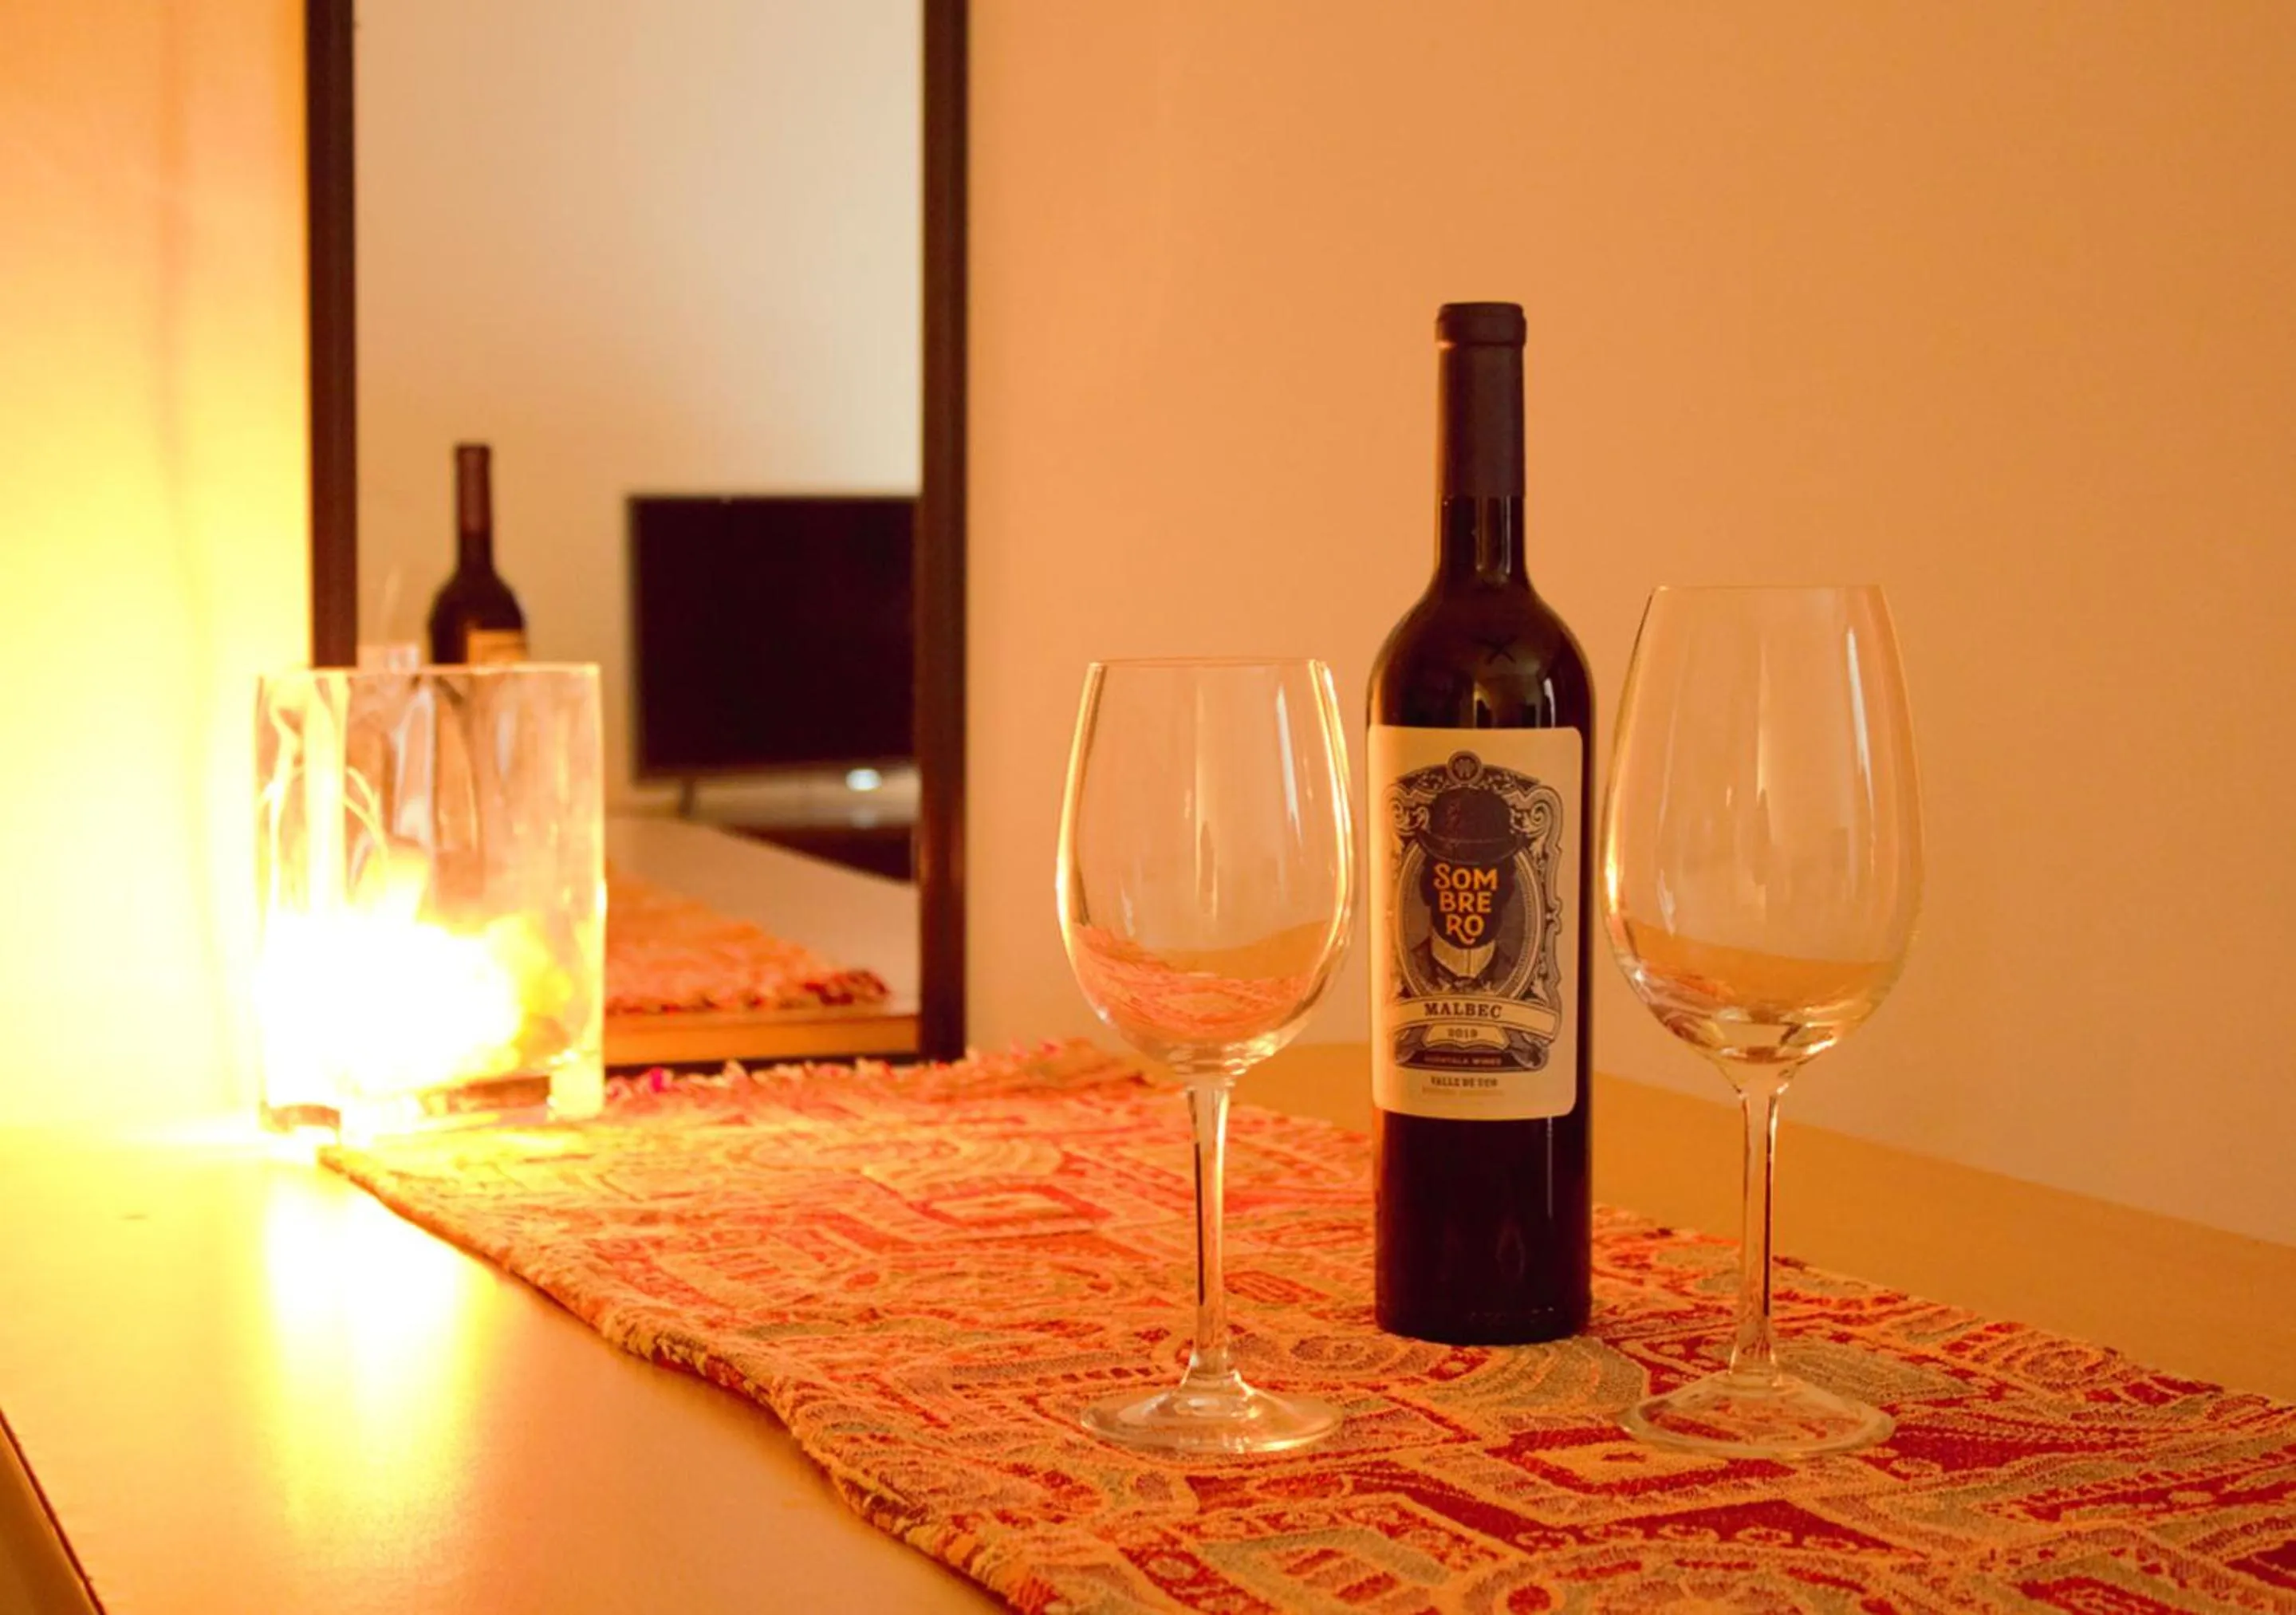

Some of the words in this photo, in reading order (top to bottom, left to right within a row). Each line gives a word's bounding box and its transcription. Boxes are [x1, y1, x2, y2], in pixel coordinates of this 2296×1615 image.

[1434, 863, 1497, 891] SOM
[1439, 892, 1491, 912] BRE
[1446, 914, 1484, 945] RO
[1424, 1002, 1502, 1018] MALBEC
